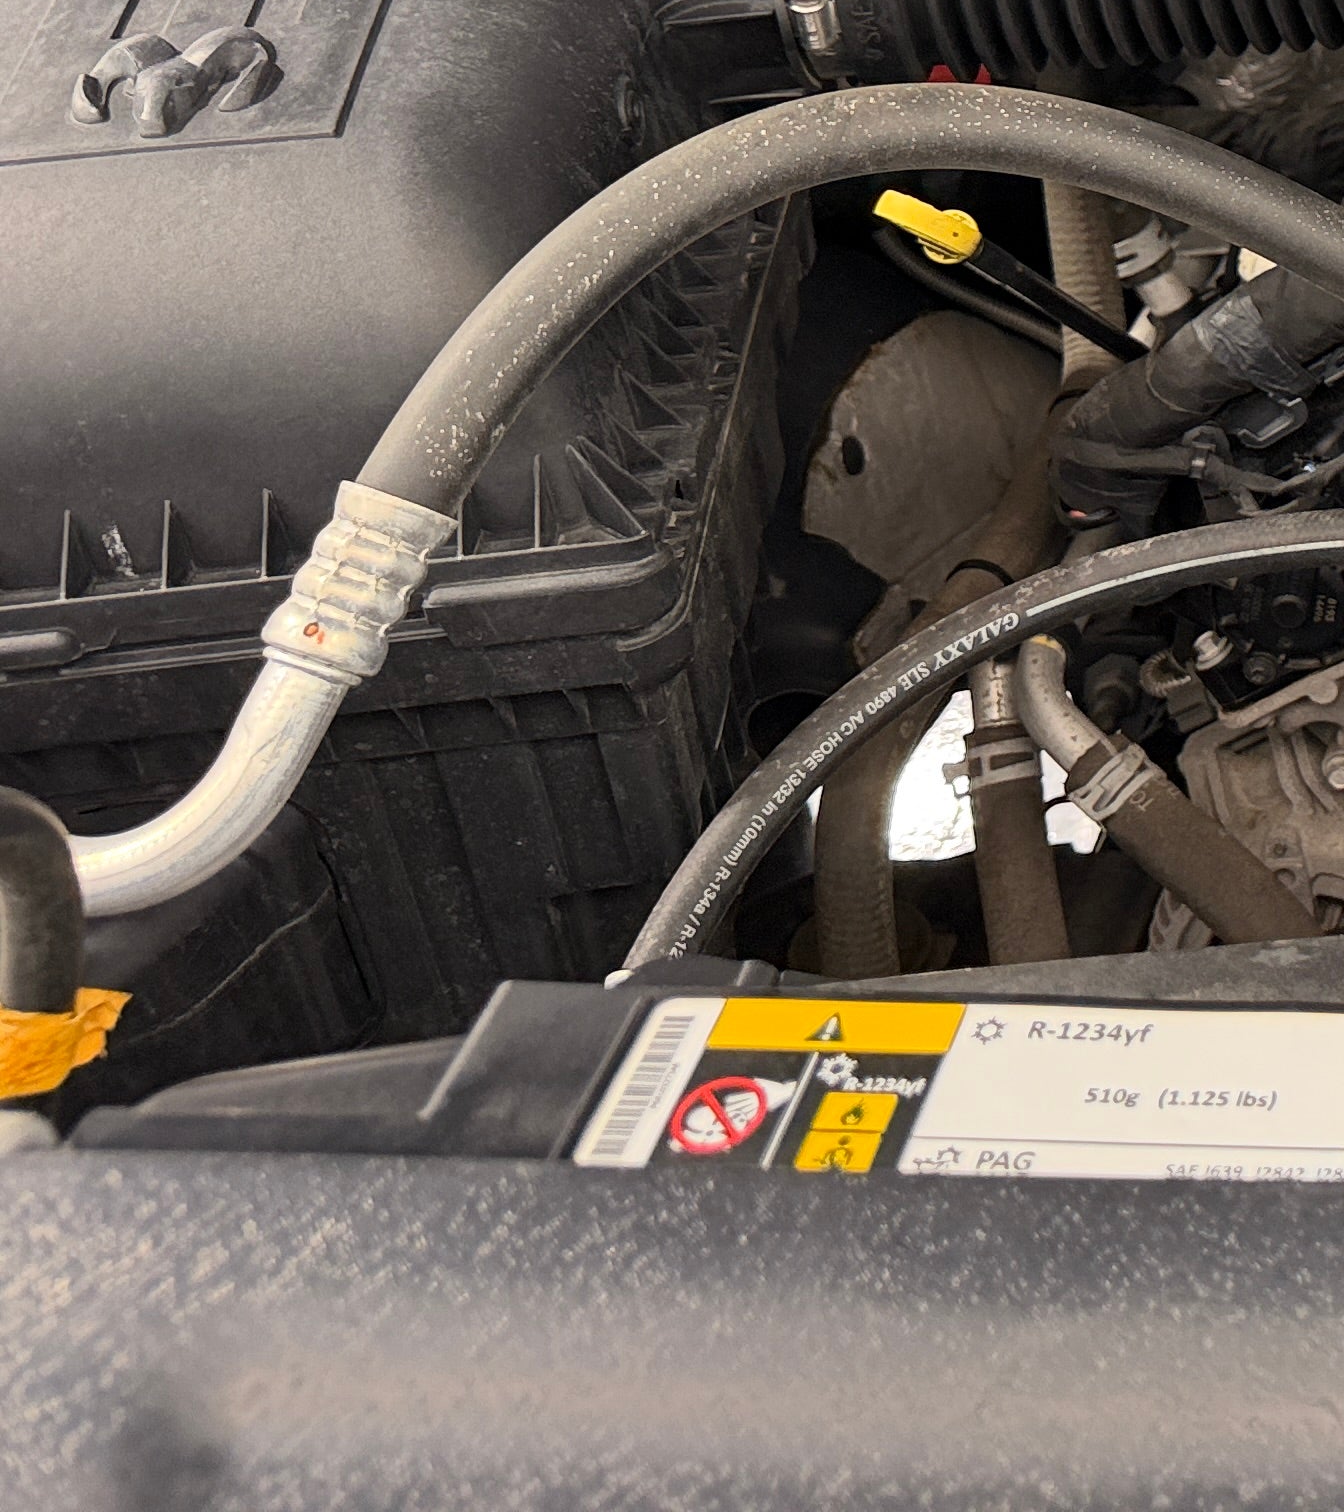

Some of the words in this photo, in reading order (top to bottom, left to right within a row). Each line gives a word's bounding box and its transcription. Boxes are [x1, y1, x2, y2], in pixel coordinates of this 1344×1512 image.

[934, 612, 1020, 672] GALAXY
[897, 660, 932, 692] SLE
[865, 684, 900, 719] 4890
[842, 710, 867, 737] A/C
[803, 728, 846, 774] HOSE
[773, 766, 808, 806] 13/32
[725, 815, 768, 869] (10mm)
[693, 867, 732, 915] R-134a
[1027, 1021, 1154, 1047] R-1234yf
[843, 1077, 927, 1099] R-1234yf
[1084, 1087, 1140, 1109] 510g
[1158, 1088, 1230, 1110] (1.125
[1236, 1090, 1278, 1112] lbs)
[976, 1150, 1036, 1172] PAG
